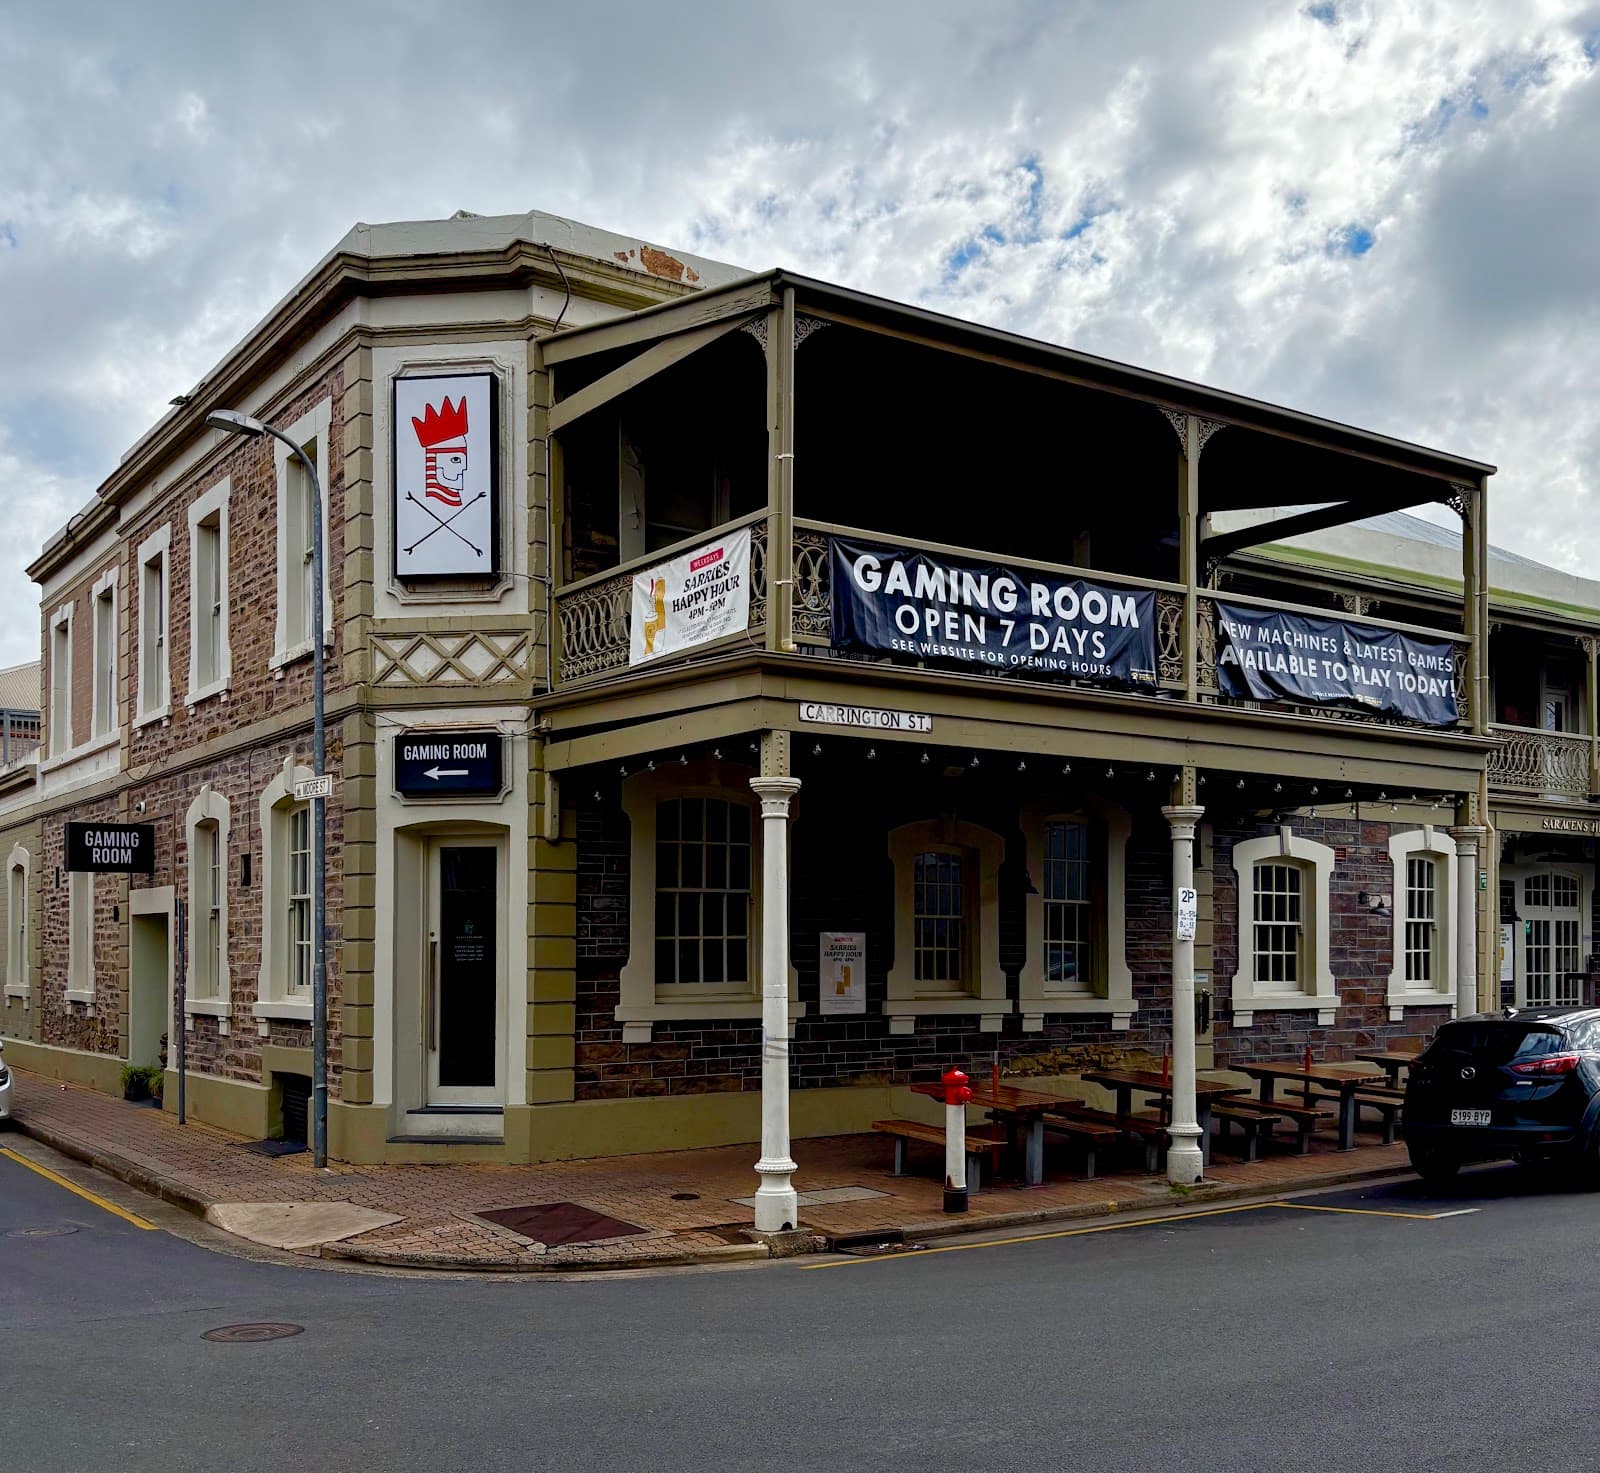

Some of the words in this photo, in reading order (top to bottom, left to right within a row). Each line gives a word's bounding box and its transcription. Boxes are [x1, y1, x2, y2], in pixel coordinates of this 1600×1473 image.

[684, 561, 730, 592] SARRIES
[853, 554, 1018, 613] GAMING
[1030, 582, 1140, 629] ROOM
[672, 586, 708, 613] HAPPY
[710, 575, 738, 599] HOUR
[895, 604, 986, 645] OPEN
[999, 618, 1016, 647] 7
[1029, 622, 1106, 659] DAYS
[1218, 619, 1252, 641] NEW
[1257, 626, 1338, 654] MACHINES
[1343, 640, 1351, 656] &
[1356, 643, 1403, 664] LATEST
[1407, 651, 1453, 673] GAMES
[891, 638, 914, 652] SEE
[920, 642, 975, 659] WEBSITE
[980, 650, 1005, 664] FOR
[1010, 653, 1067, 670] OPENING
[1072, 660, 1112, 676] HOURS
[1321, 660, 1347, 682] TO
[1351, 664, 1392, 688] PLAY
[1396, 671, 1456, 698] TODAY!
[806, 704, 900, 728] CARRINGTON
[403, 744, 450, 761] GAMING
[453, 743, 487, 760] ROOM
[84, 830, 140, 848] GAMING
[92, 847, 132, 865] ROOM
[1181, 889, 1195, 903] 2P
